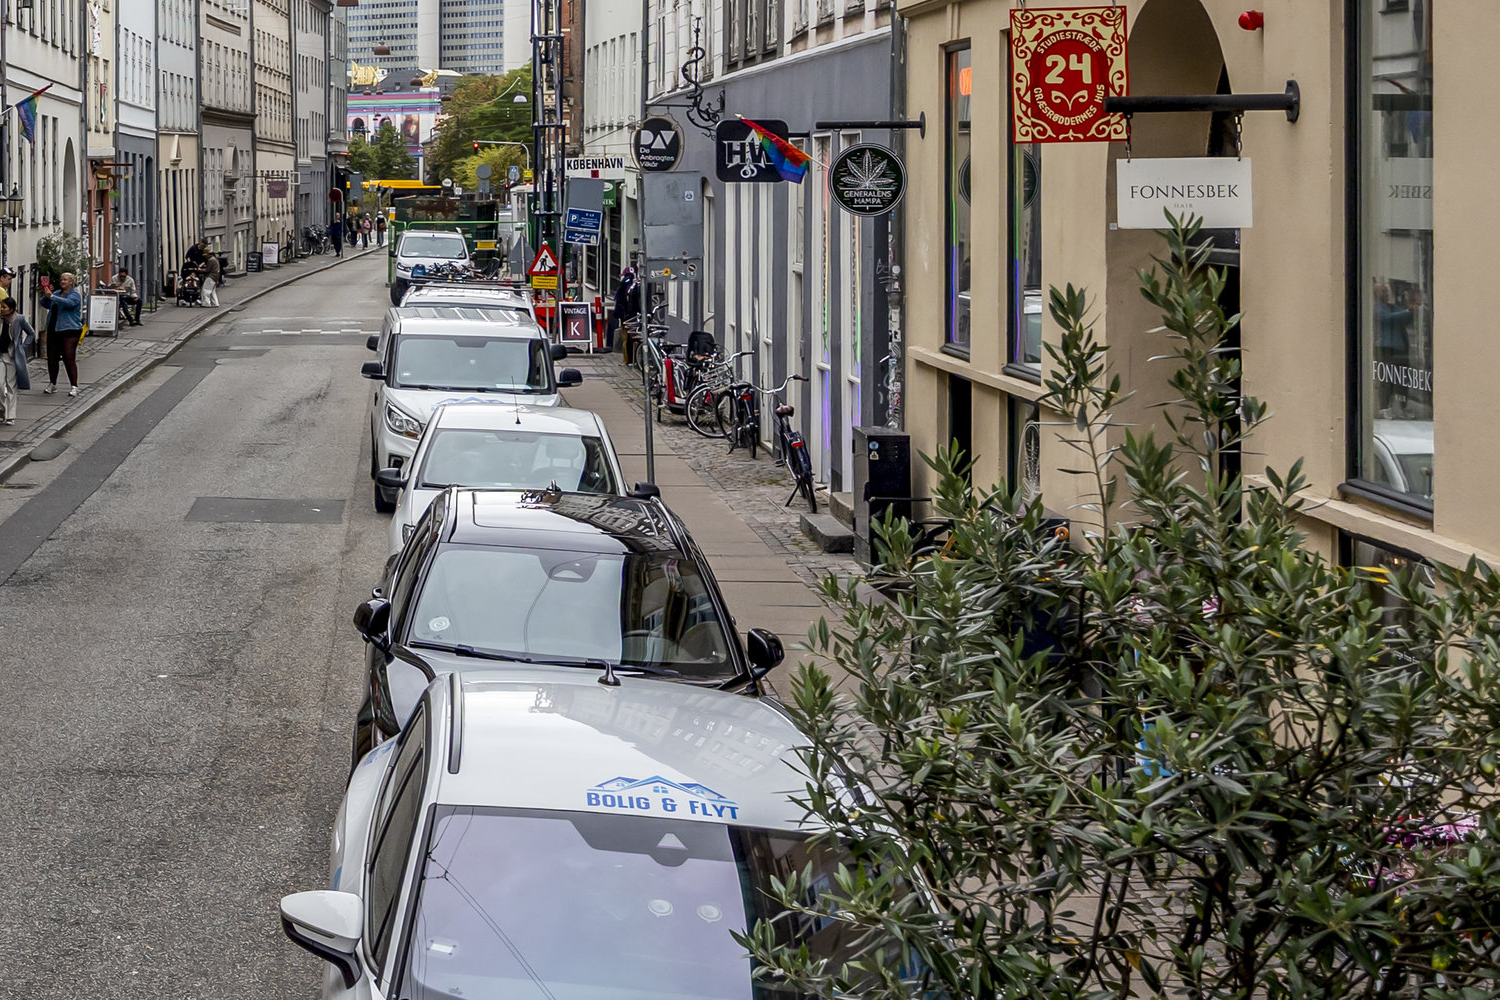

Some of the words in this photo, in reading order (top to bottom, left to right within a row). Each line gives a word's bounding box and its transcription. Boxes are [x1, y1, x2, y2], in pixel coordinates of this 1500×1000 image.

[1036, 31, 1101, 55] STUDIESTRÆDE
[1044, 52, 1092, 84] 24
[1033, 87, 1098, 126] GRÆSRØDDERNES
[1094, 84, 1105, 104] HUS
[566, 157, 624, 170] KØBENHAVN
[843, 190, 892, 198] GENERALENS
[1130, 184, 1239, 199] FONNESBEK
[854, 197, 882, 205] HAMPA
[571, 214, 578, 222] P
[563, 307, 588, 315] VINTAGE
[570, 321, 581, 336] K
[1372, 360, 1432, 393] FONNESBEK
[586, 791, 651, 810] BOLIG
[661, 797, 678, 812] &
[689, 800, 739, 820] FLYT
